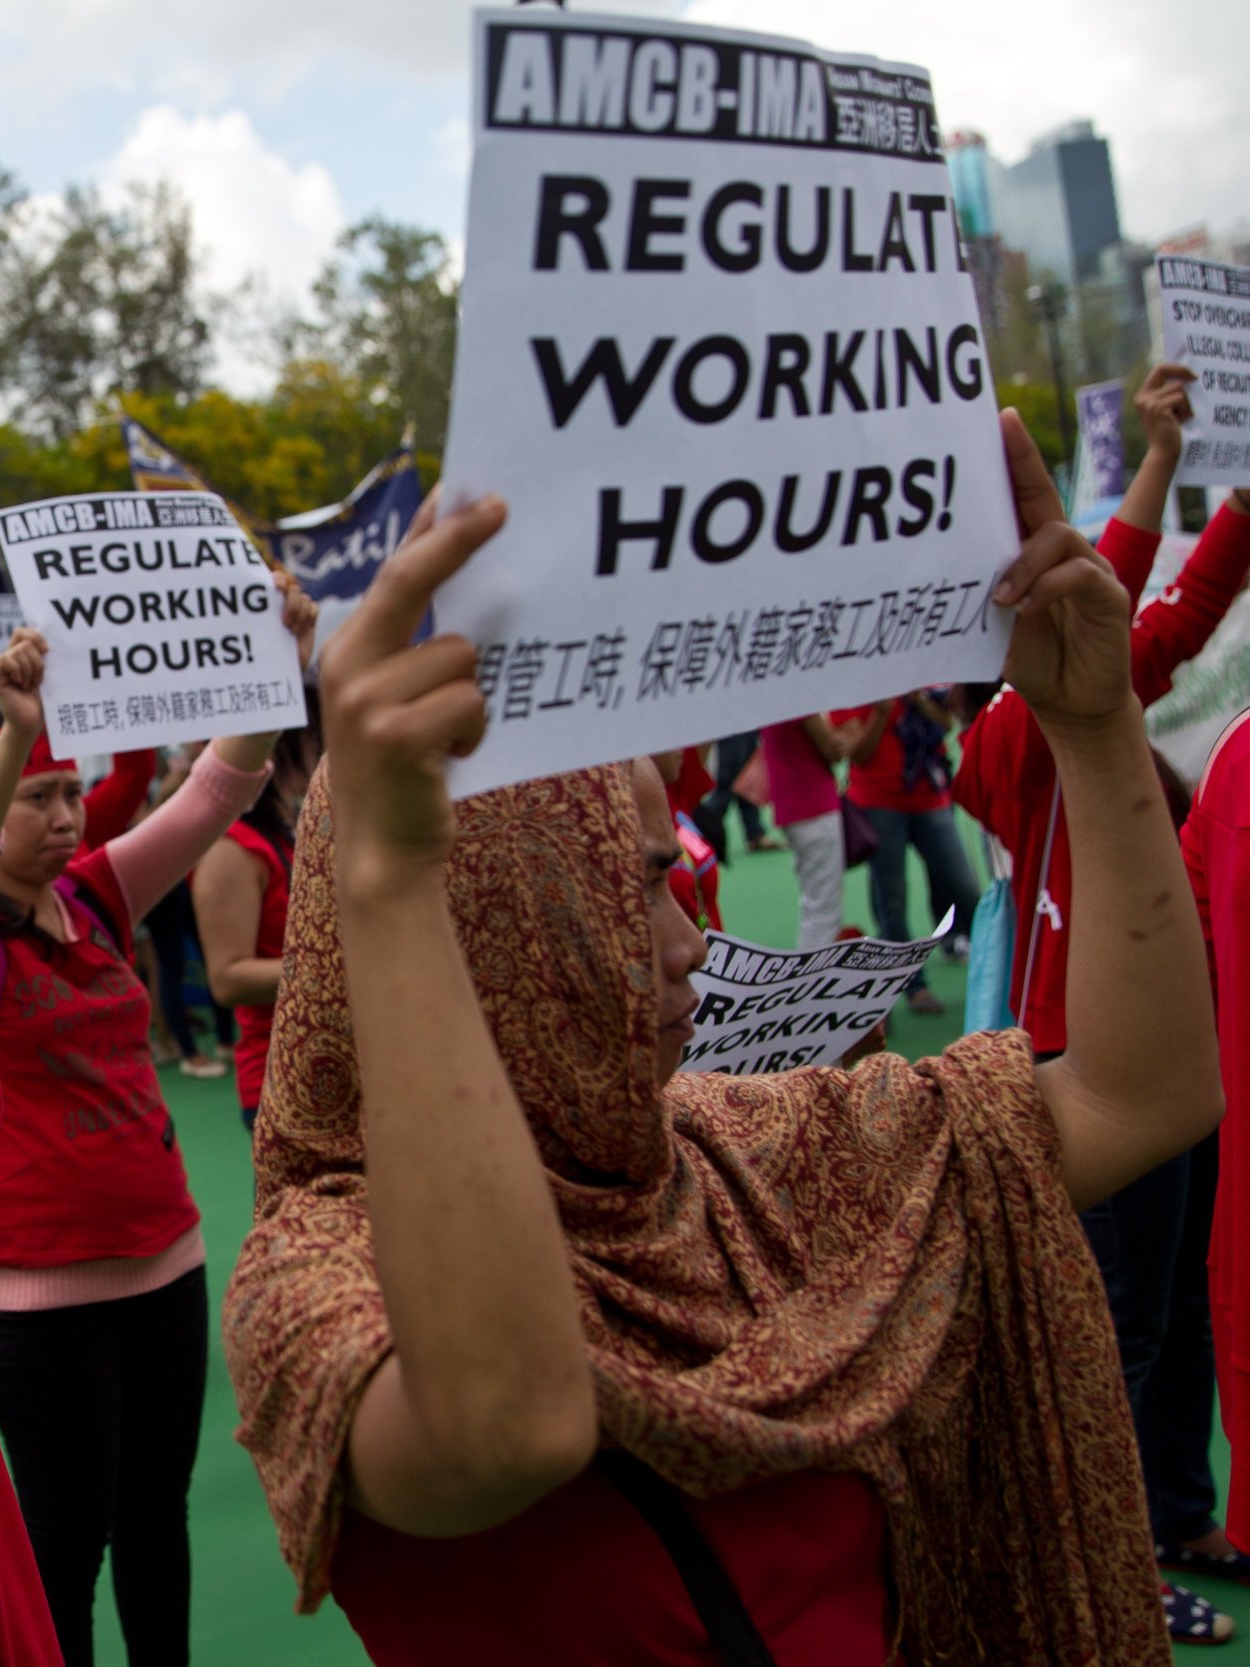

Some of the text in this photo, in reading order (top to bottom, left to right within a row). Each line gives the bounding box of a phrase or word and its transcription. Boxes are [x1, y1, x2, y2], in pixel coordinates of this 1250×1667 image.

[491, 31, 828, 142] AMCB-IMA
[530, 323, 983, 429] WORKING
[4, 500, 155, 543] AMCB-IMA
[595, 454, 956, 577] HOURS!
[33, 538, 261, 580] REGULATE
[52, 583, 269, 631] WORKING
[90, 634, 255, 680] HOURS!
[701, 939, 851, 986] AMCB-IMA
[680, 1008, 888, 1065] WORKING
